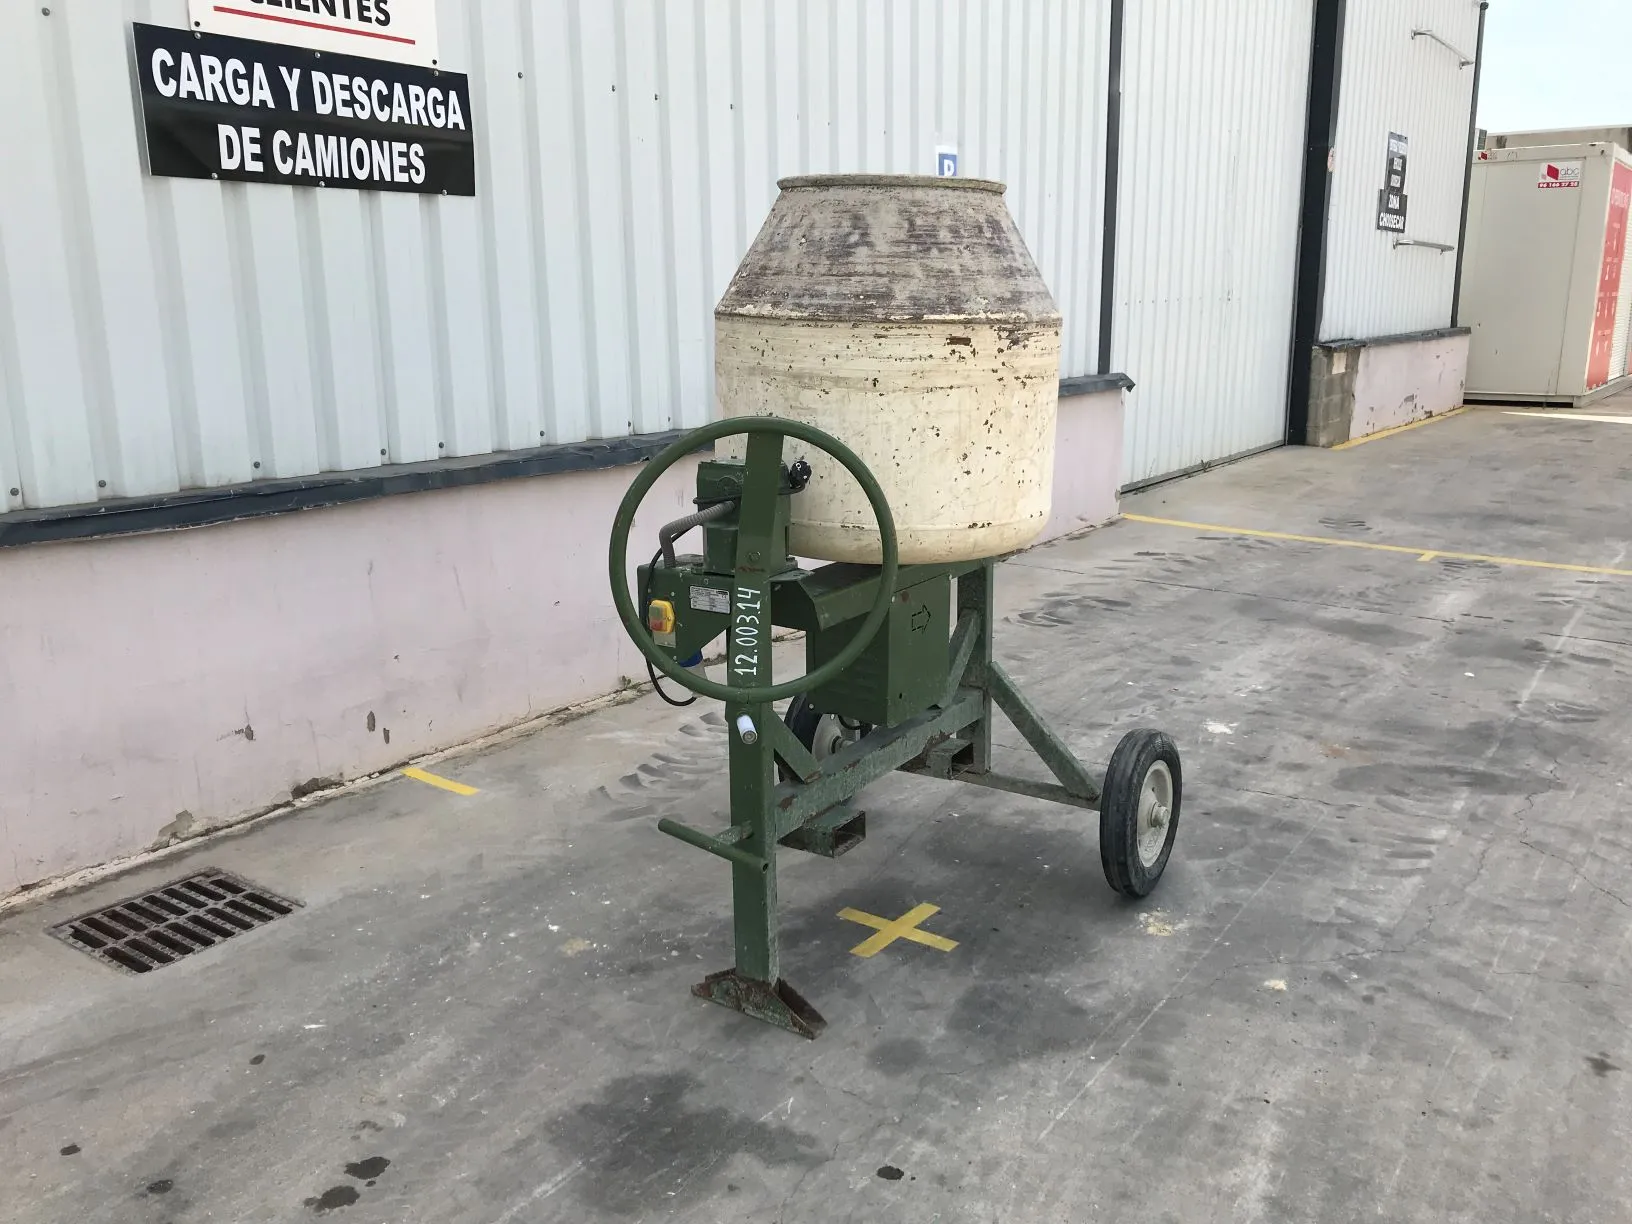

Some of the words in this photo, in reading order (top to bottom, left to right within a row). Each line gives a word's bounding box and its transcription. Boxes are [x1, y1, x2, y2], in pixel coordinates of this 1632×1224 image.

[151, 47, 276, 109] CARGA
[278, 65, 301, 112] Y
[310, 70, 466, 131] DESCARGA
[217, 123, 265, 172] DE
[272, 129, 427, 184] CAMIONES
